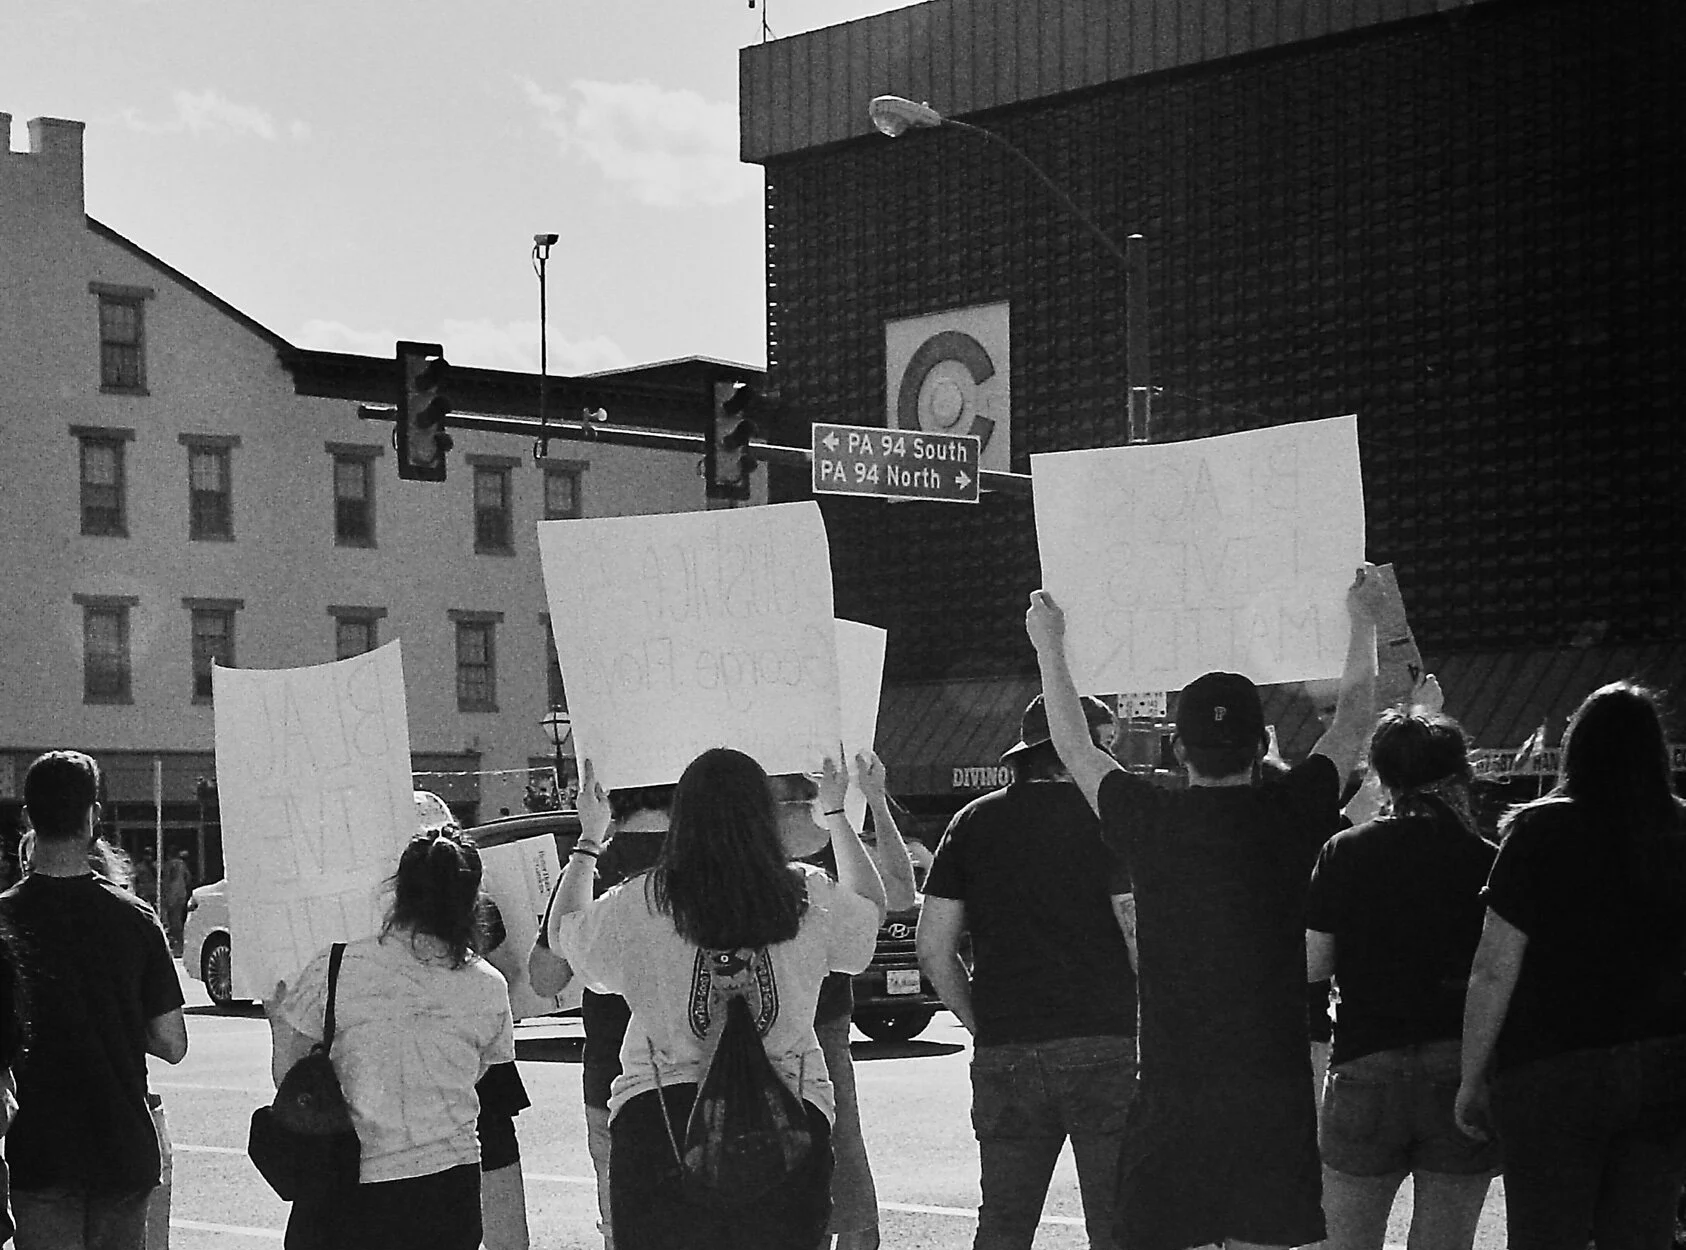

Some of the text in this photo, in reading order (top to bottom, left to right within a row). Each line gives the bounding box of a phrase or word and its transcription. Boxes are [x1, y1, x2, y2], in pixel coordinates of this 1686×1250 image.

[848, 433, 967, 463] PA 94 South
[820, 459, 941, 489] PA 94 North
